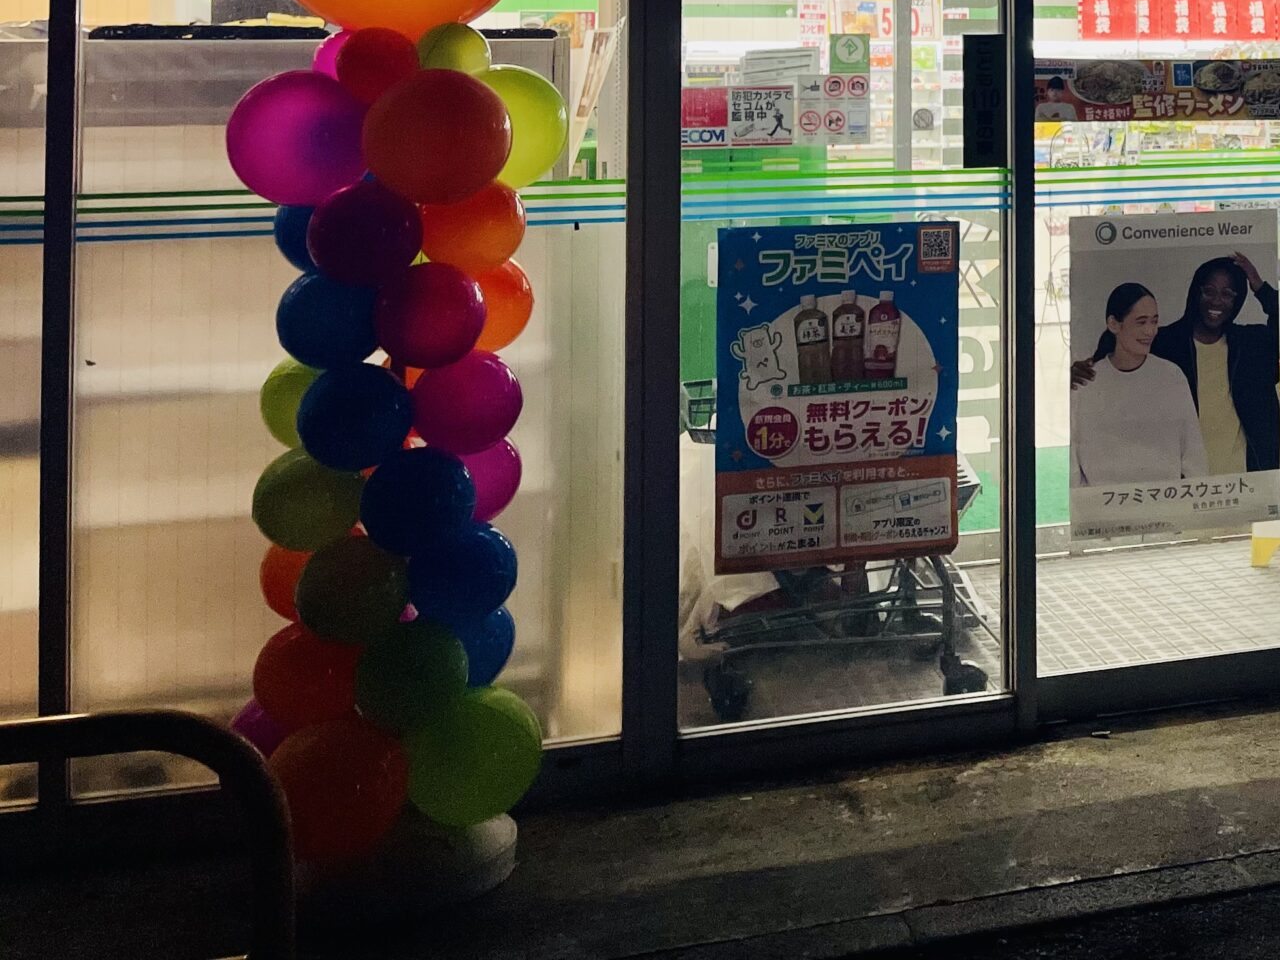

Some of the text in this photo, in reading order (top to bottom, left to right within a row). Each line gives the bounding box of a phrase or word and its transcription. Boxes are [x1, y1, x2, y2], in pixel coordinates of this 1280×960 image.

[732, 101, 775, 111] セコムが
[1132, 92, 1244, 118] 監修ラーメン
[731, 111, 767, 122] 監視中
[681, 129, 725, 143] ECOM
[794, 231, 882, 249] ファミマのアプリ
[1122, 222, 1253, 240] Convenience Wear
[760, 243, 914, 286] ファミペイ
[806, 397, 929, 422] 無料クーポン
[804, 418, 926, 452] もらえる!
[1102, 478, 1254, 506] ファミマのスウェット。
[769, 526, 794, 536] POINT
